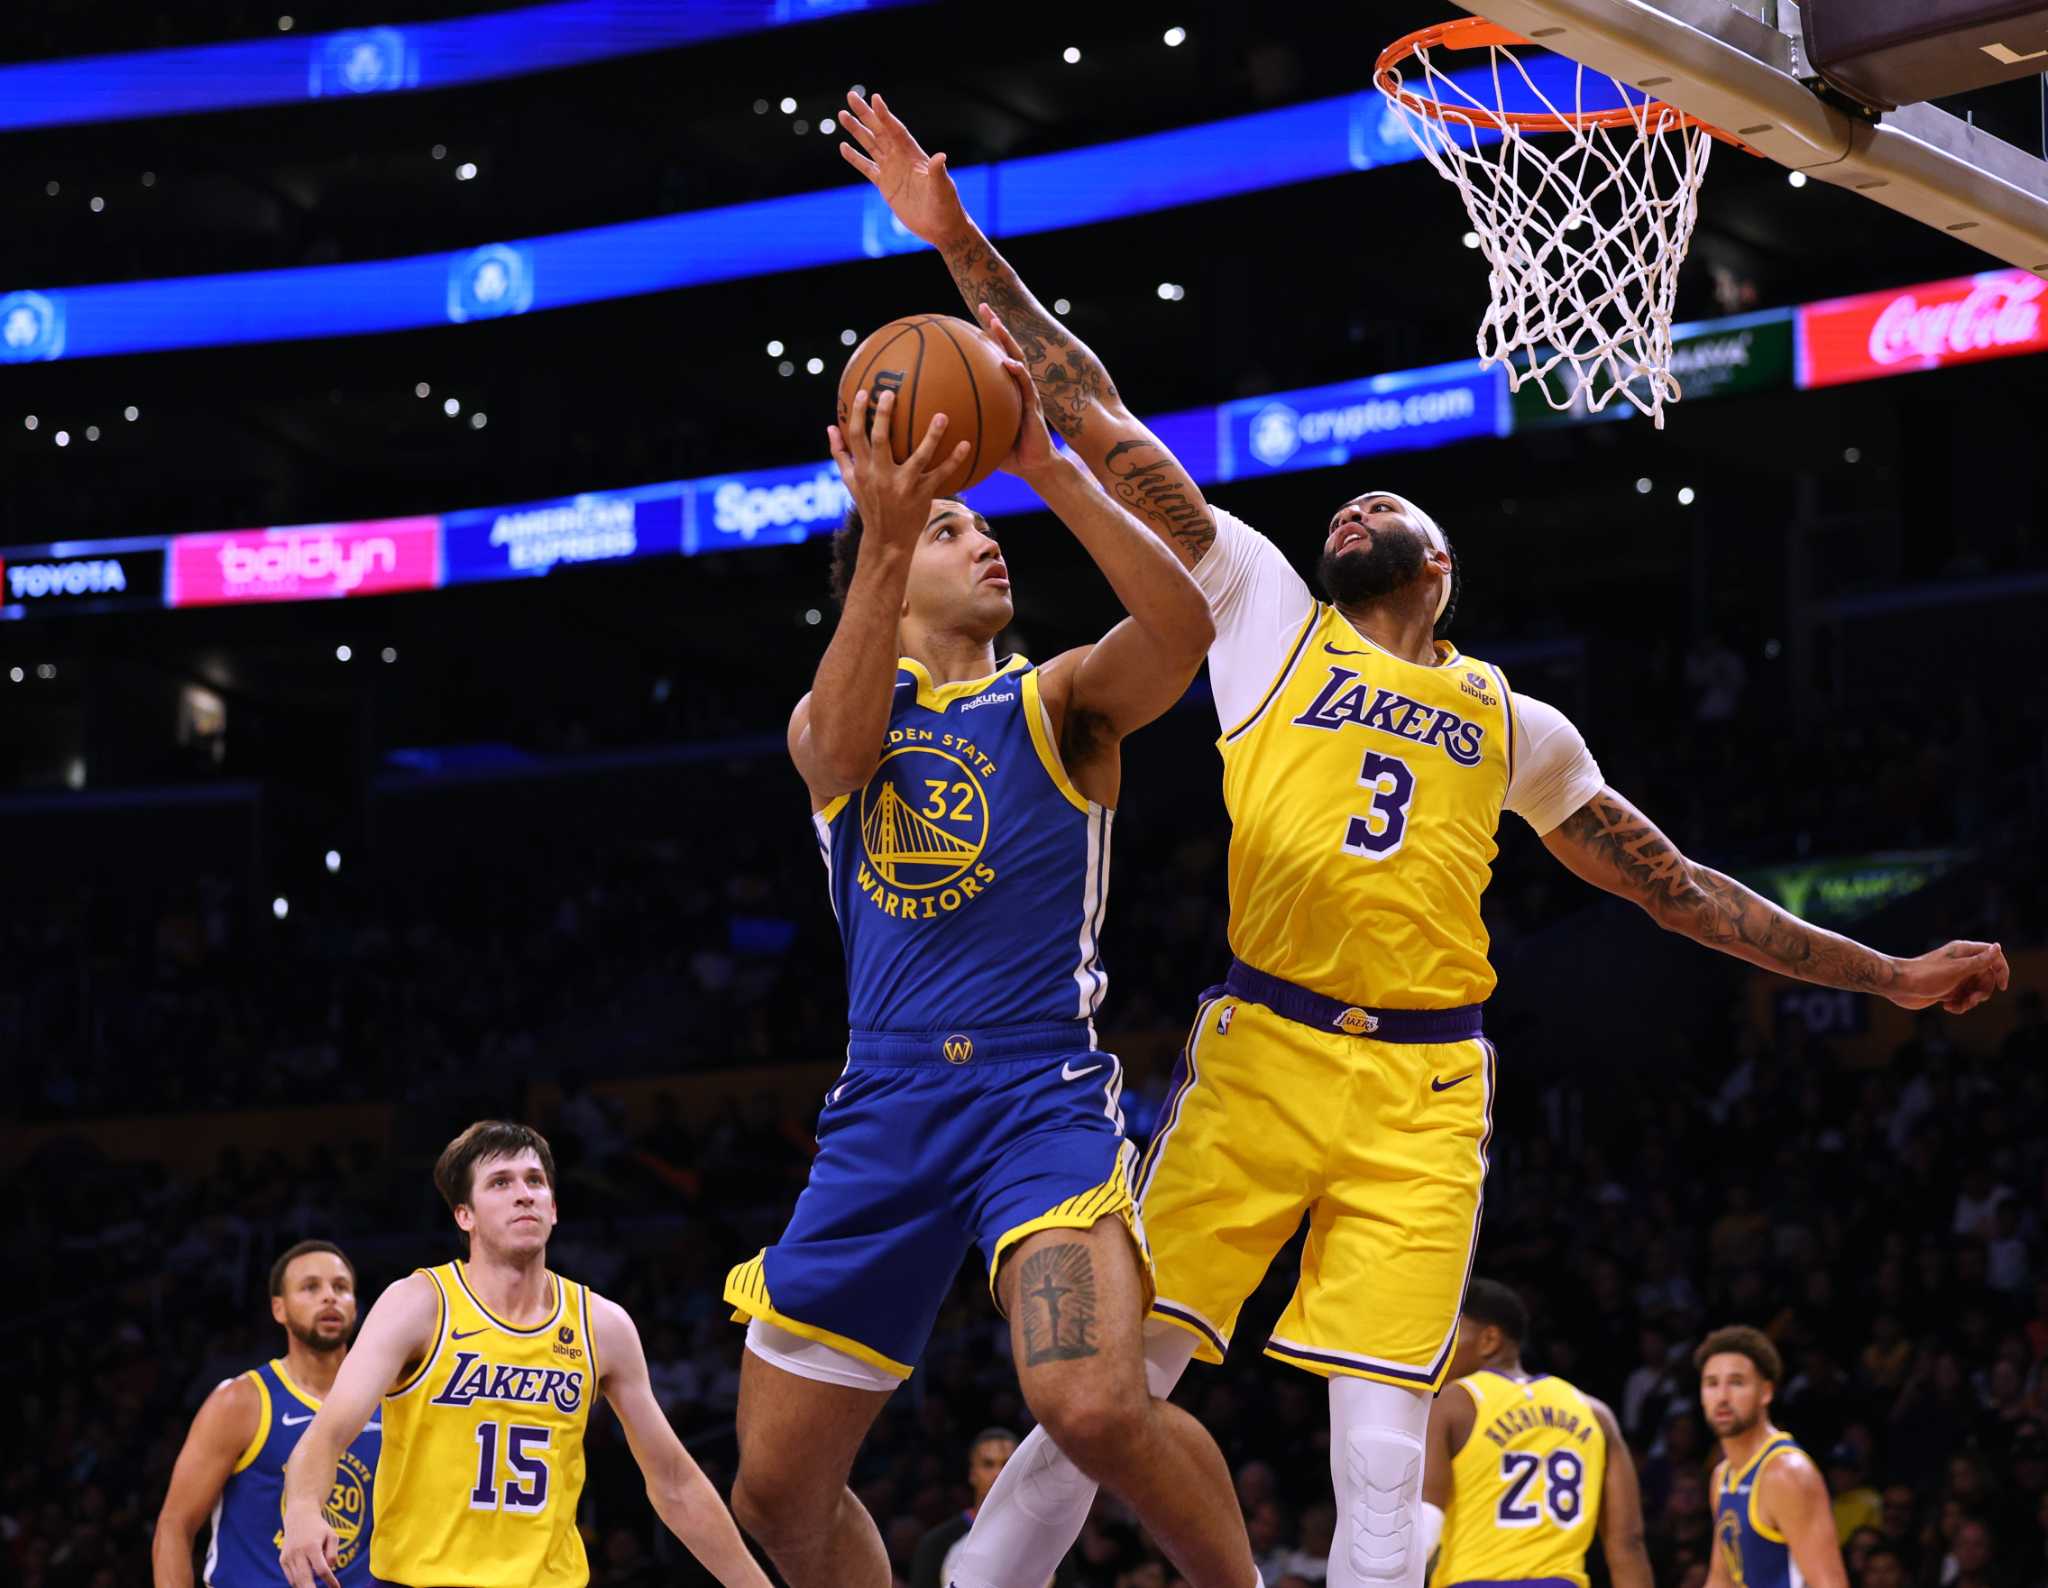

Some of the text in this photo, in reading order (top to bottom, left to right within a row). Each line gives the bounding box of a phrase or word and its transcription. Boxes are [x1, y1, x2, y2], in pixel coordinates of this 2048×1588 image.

[1300, 388, 1475, 443] crypto.com
[7, 559, 126, 598] TOYOTA
[961, 692, 1014, 713] Rakuten
[1460, 682, 1497, 706] bibigo
[1291, 665, 1486, 768] LAKERS
[942, 734, 997, 778] STATE
[922, 779, 975, 821] 32
[1341, 748, 1416, 862] 3
[857, 861, 996, 919] WARRIORS
[553, 1343, 582, 1359] bibigo
[431, 1352, 584, 1414] LAKERS
[1484, 1406, 1593, 1447] HACHIMURA
[469, 1421, 552, 1514] 15
[1495, 1447, 1584, 1530] 28
[329, 1484, 359, 1513] 30
